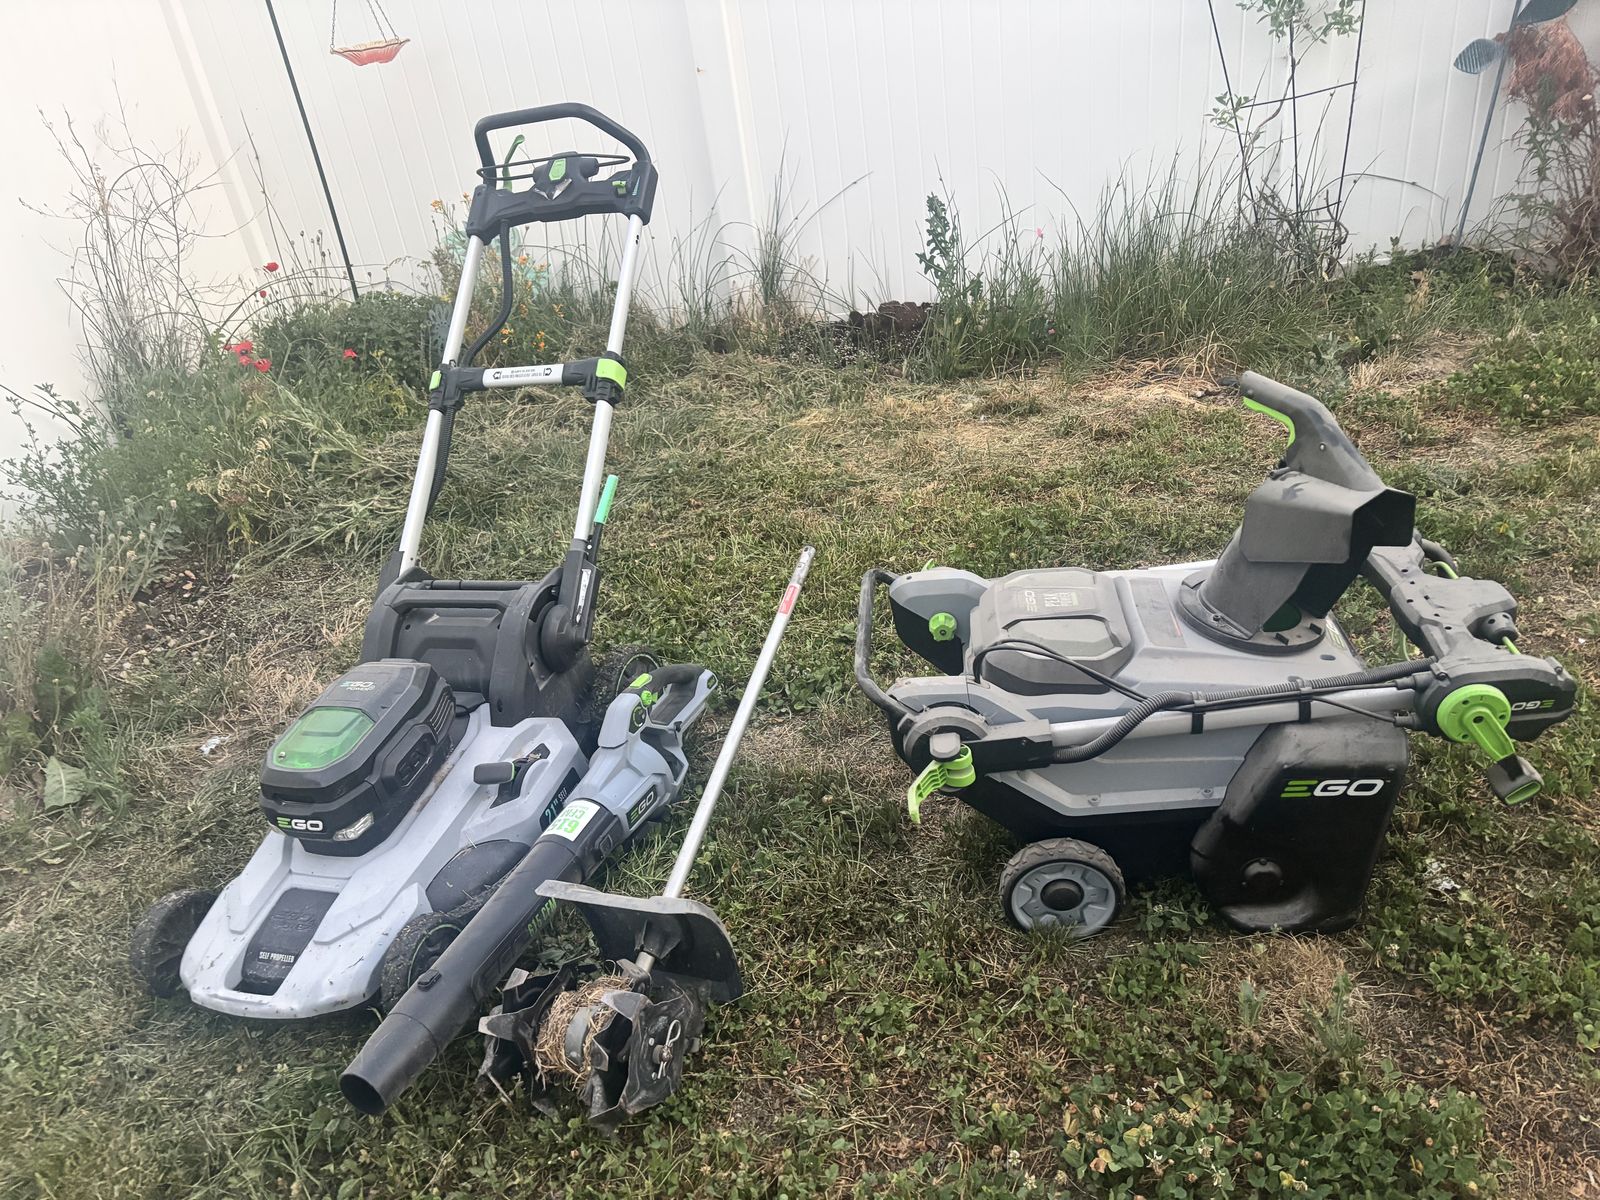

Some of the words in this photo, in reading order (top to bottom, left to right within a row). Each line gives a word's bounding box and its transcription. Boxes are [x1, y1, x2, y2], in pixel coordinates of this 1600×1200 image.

[1511, 700, 1555, 711] EGO
[1281, 779, 1385, 798] EGO
[630, 791, 654, 823] EGO
[277, 817, 323, 831] EGO
[528, 914, 542, 938] 615
[259, 951, 270, 960] SELF
[270, 953, 295, 963] PROPELLED
